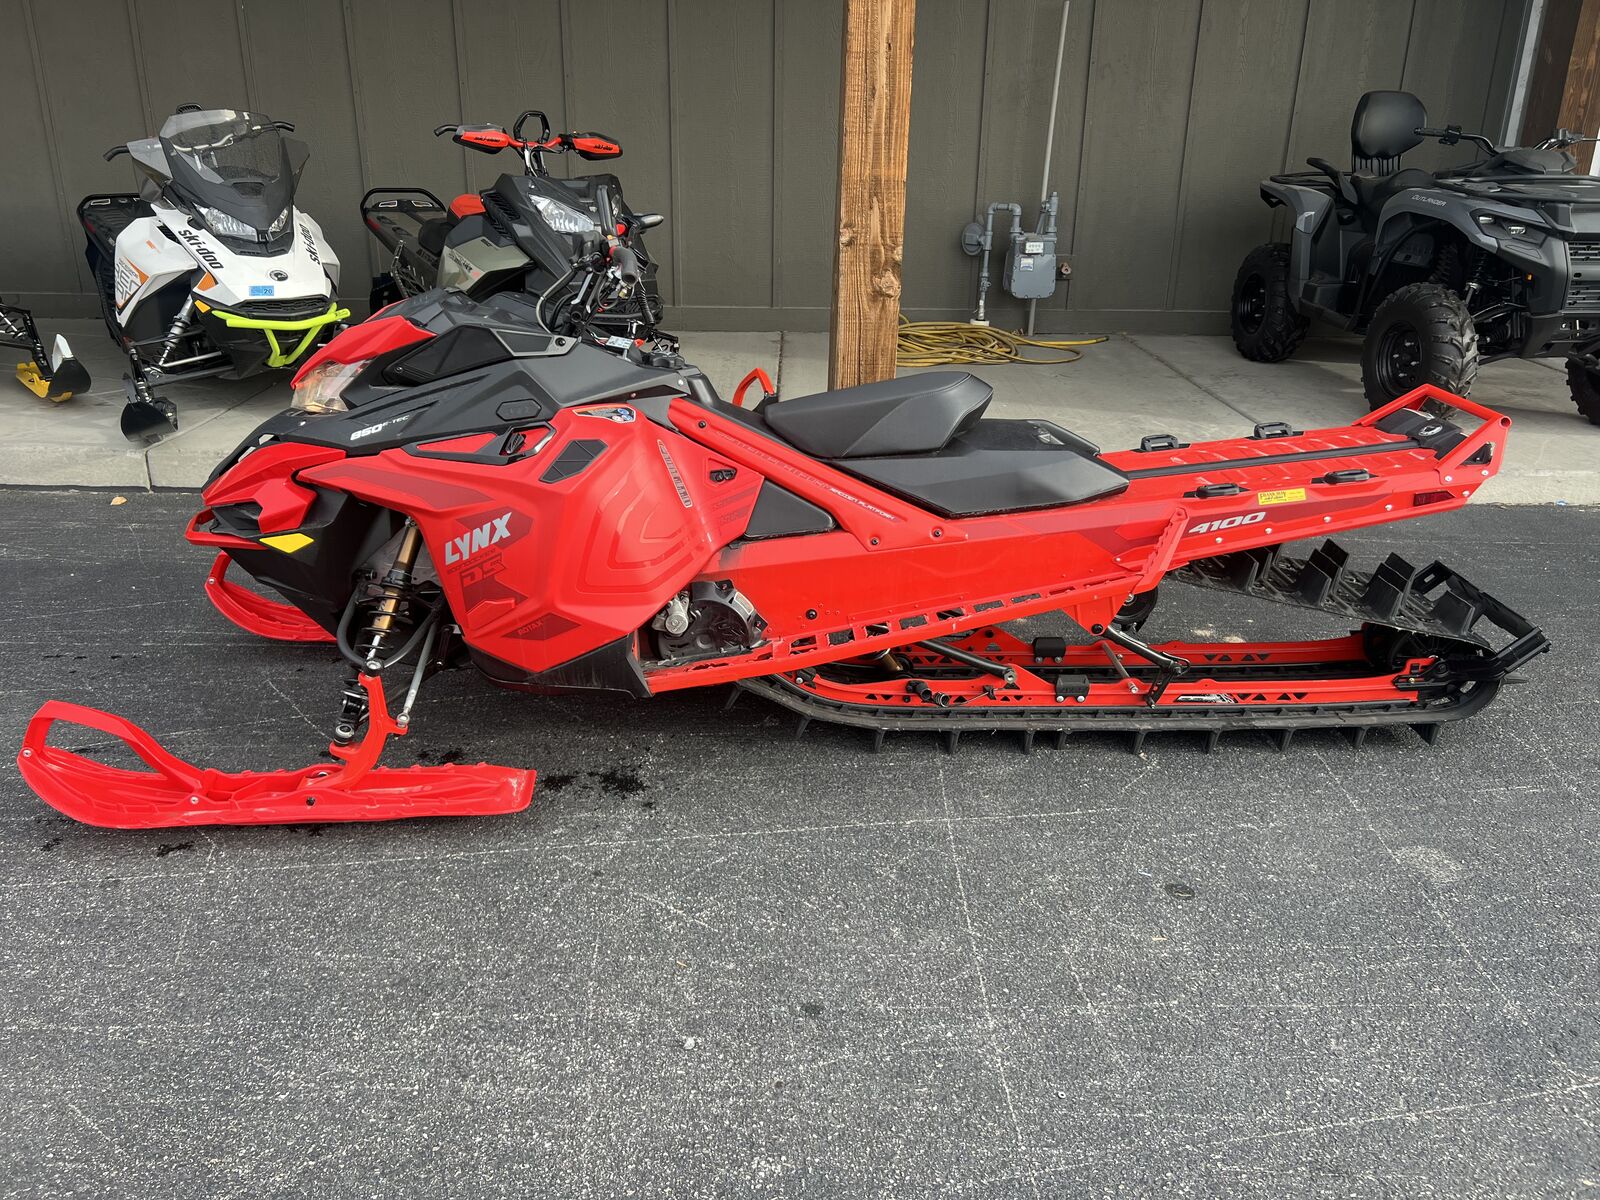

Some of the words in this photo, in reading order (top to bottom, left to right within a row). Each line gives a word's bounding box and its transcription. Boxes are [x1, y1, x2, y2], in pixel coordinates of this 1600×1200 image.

[1411, 195, 1447, 206] OUTLANDER
[178, 229, 225, 270] ski-doo
[299, 223, 321, 266] ski-doo
[350, 423, 383, 441] 850
[858, 500, 895, 520] PLATFORM
[1188, 511, 1266, 534] 4100
[444, 511, 512, 566] LYNX
